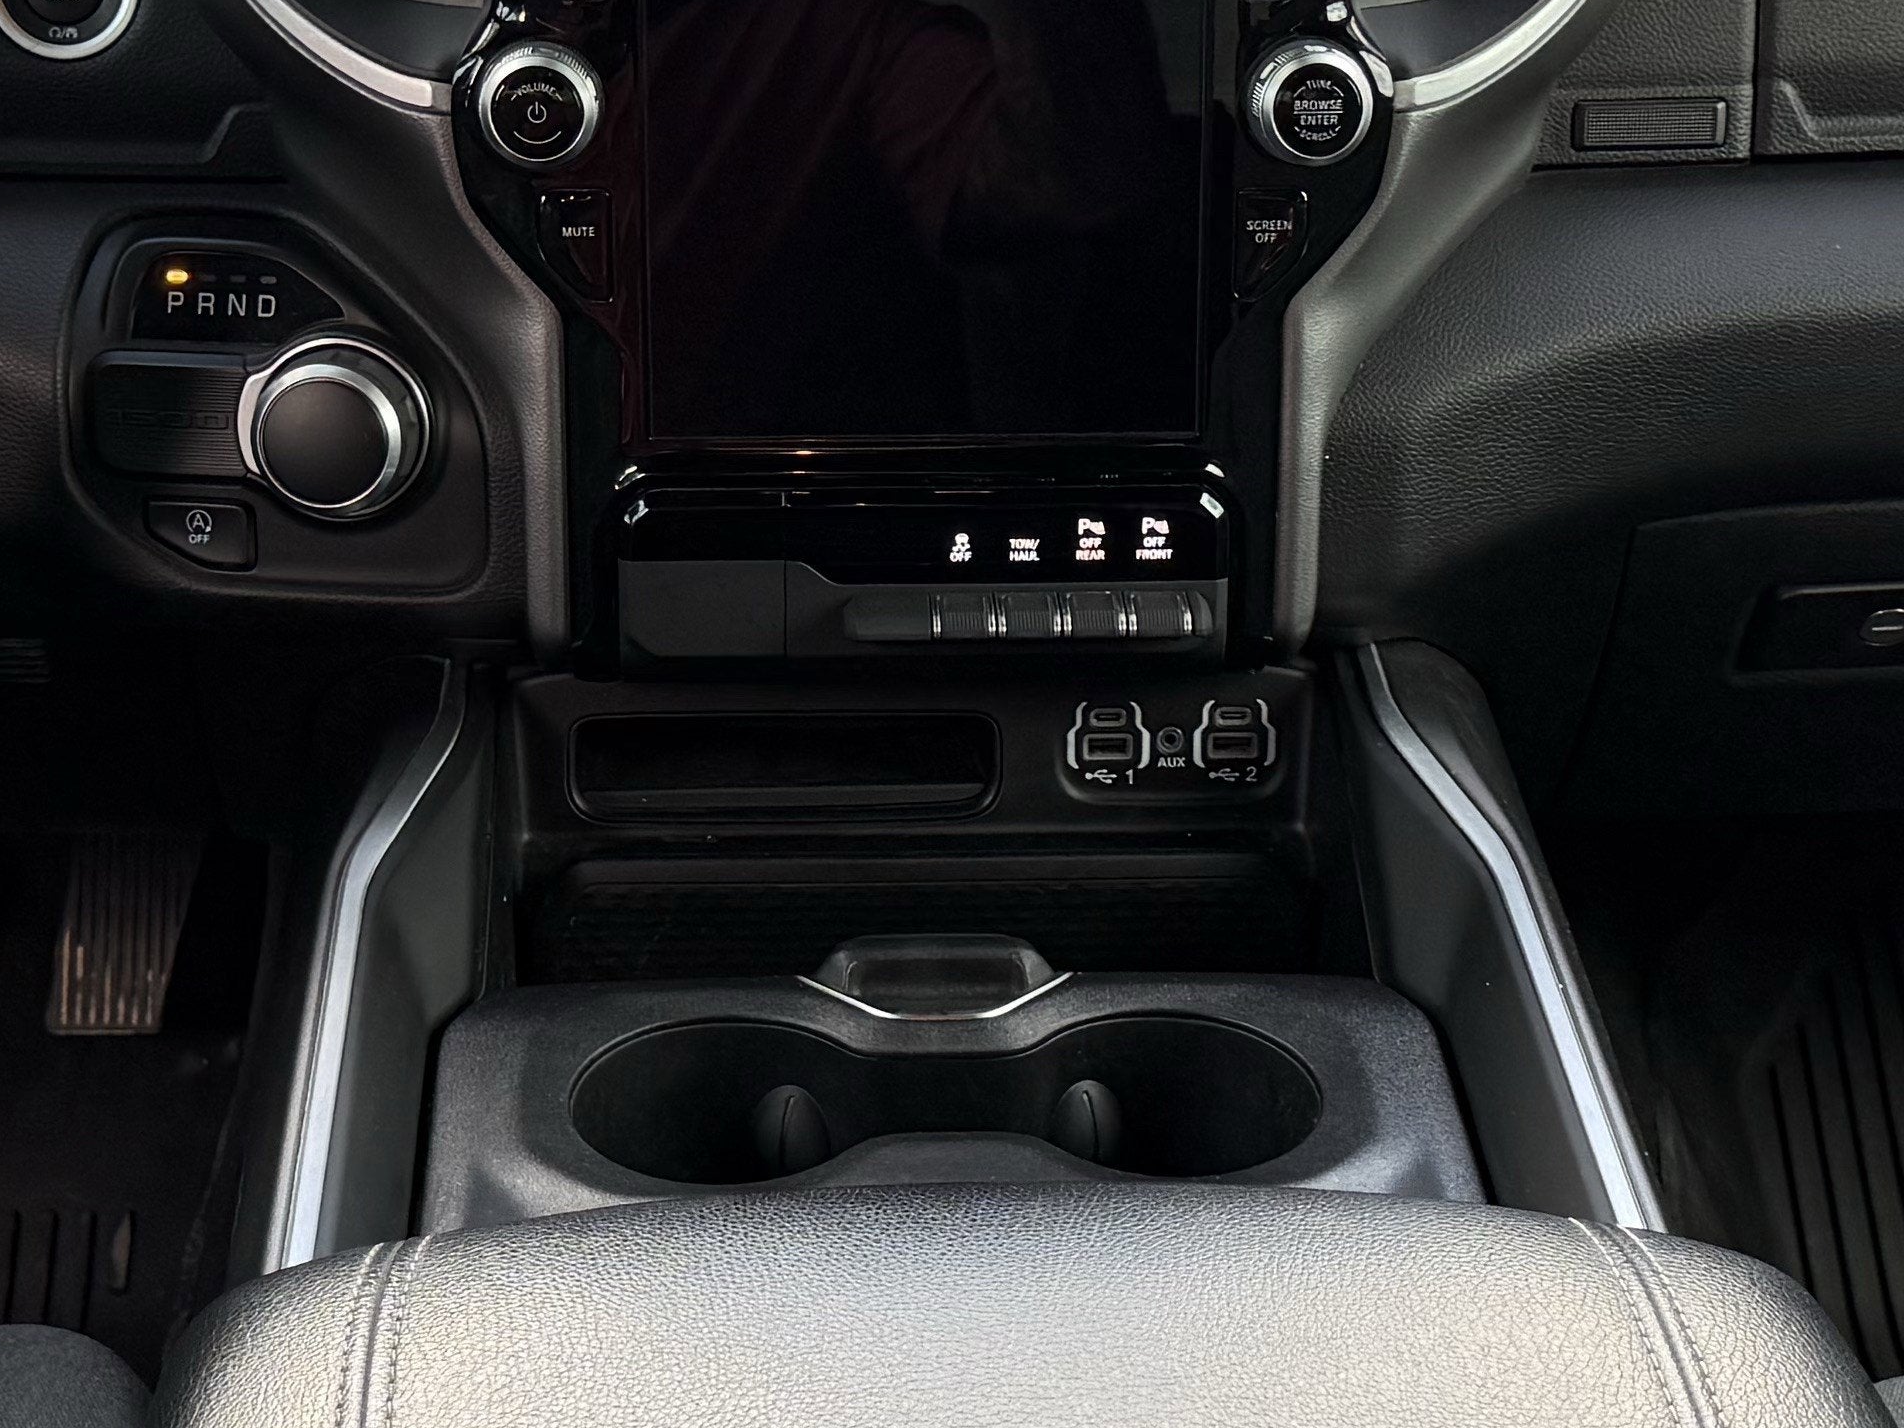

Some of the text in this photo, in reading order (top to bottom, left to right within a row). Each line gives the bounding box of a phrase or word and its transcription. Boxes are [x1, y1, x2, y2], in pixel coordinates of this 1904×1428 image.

[514, 82, 558, 98] VOLUME
[1293, 99, 1344, 111] BROWSE
[1299, 115, 1340, 126] ENTER
[1299, 128, 1338, 142] SCROLL
[1246, 219, 1294, 231] SCREEN
[561, 226, 596, 239] MUTE
[1255, 232, 1278, 244] OFF
[167, 291, 277, 318] P R N D
[188, 534, 211, 545] OFF
[1009, 538, 1041, 550] TOW/
[1079, 537, 1103, 549] OFF
[1143, 537, 1167, 548] OFF
[949, 551, 973, 563] OFF
[1009, 551, 1041, 562] HAUL
[1075, 549, 1106, 561] REAR
[1135, 549, 1174, 561] FRONT
[1156, 755, 1187, 769] AUX
[1125, 768, 1135, 785] 1
[1245, 765, 1258, 783] 2
